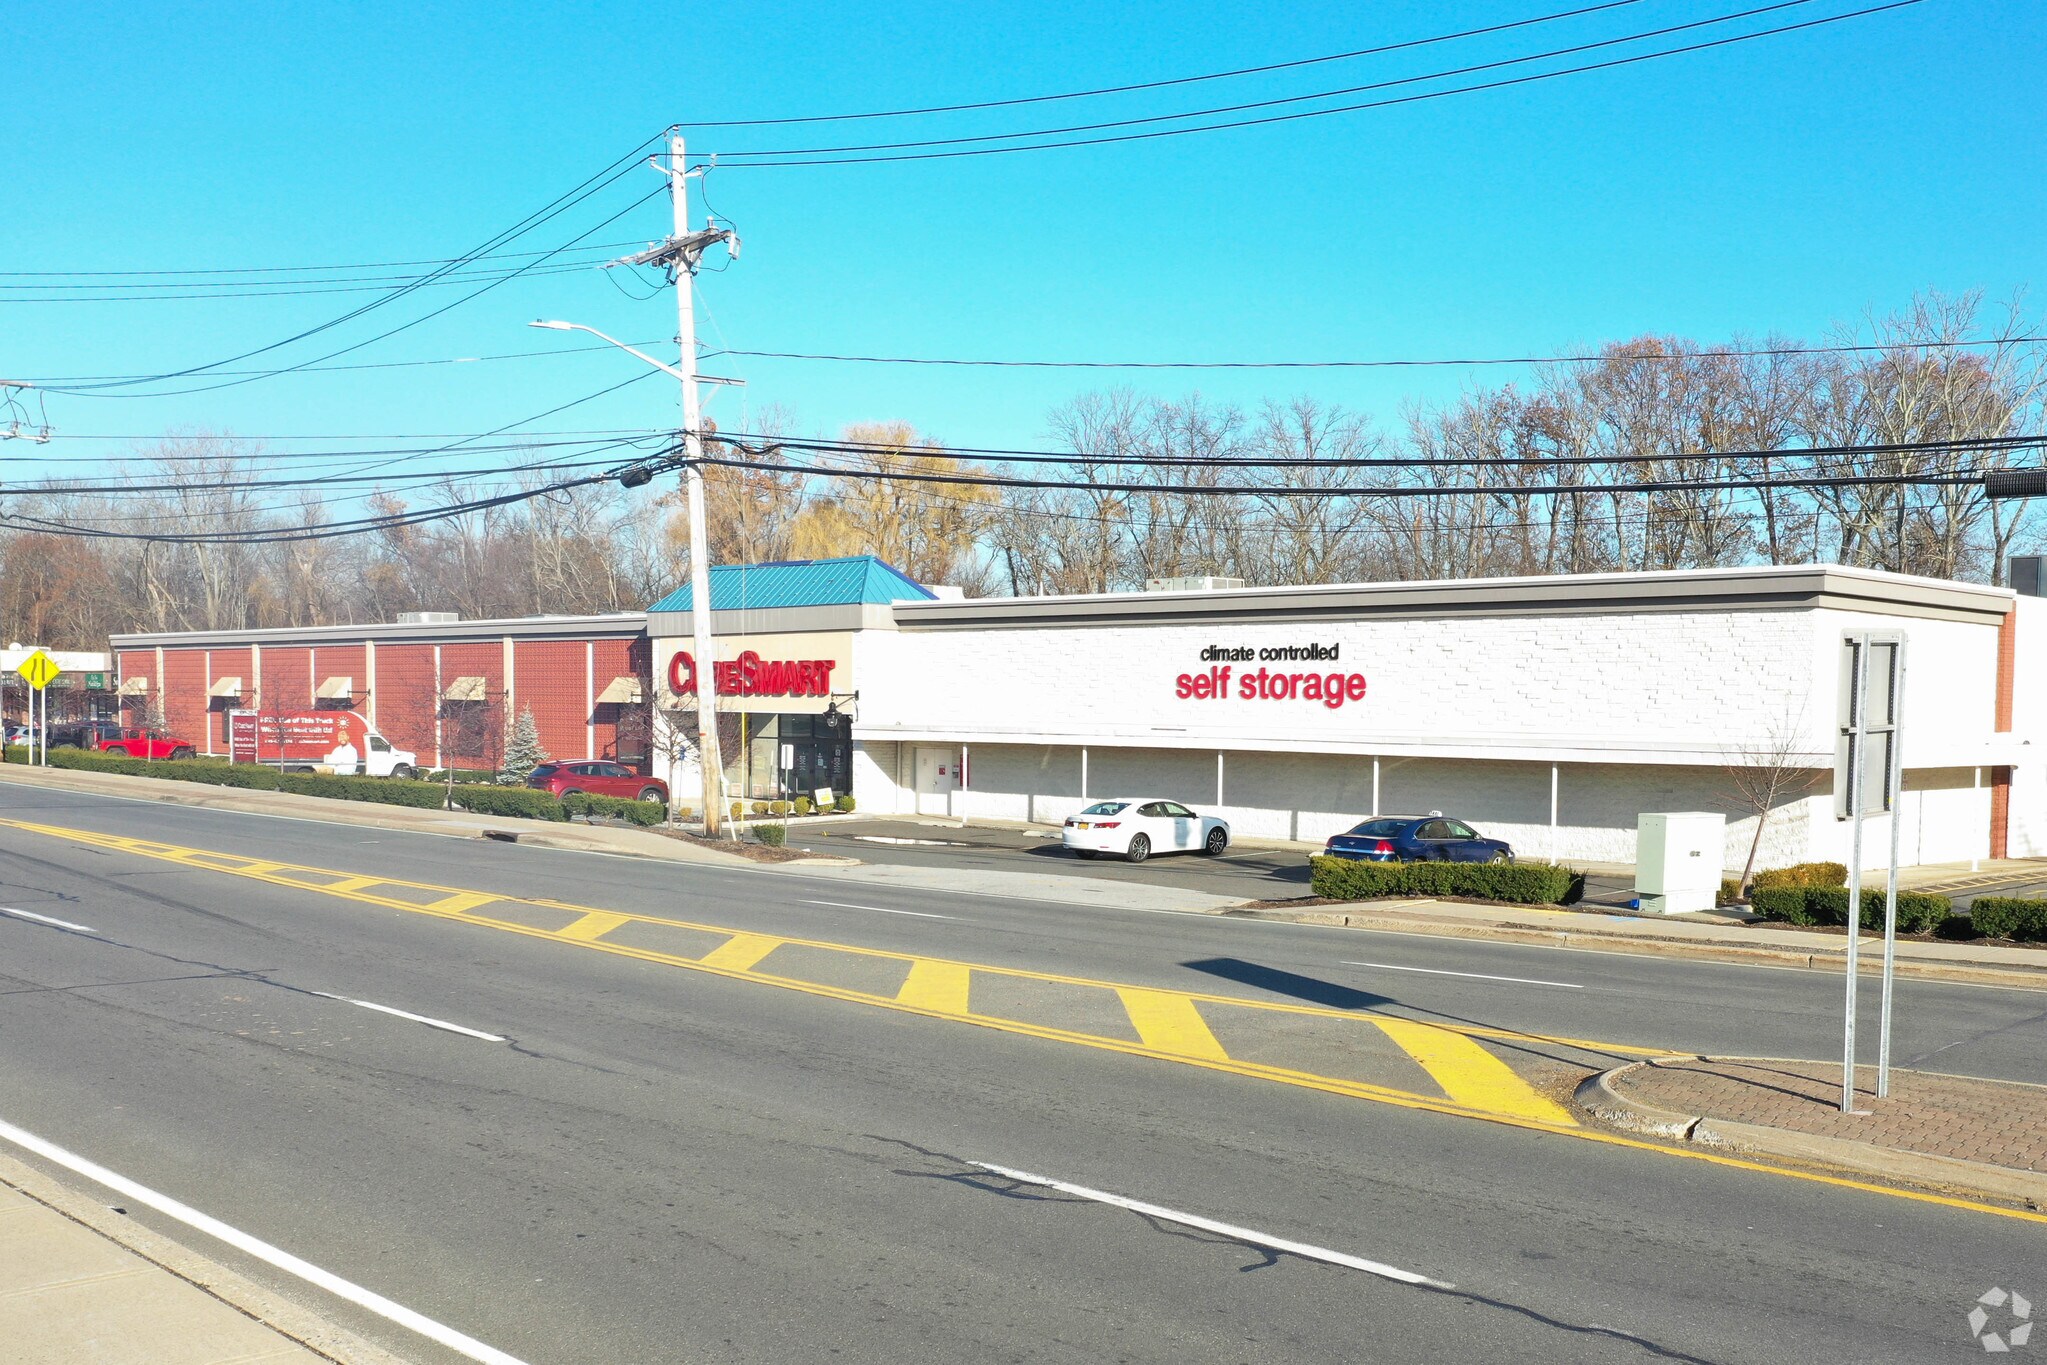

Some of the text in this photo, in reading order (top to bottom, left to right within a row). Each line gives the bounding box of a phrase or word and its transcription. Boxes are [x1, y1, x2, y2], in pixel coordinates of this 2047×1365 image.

[1200, 643, 1339, 661] climate controlled
[1176, 666, 1367, 709] self storage
